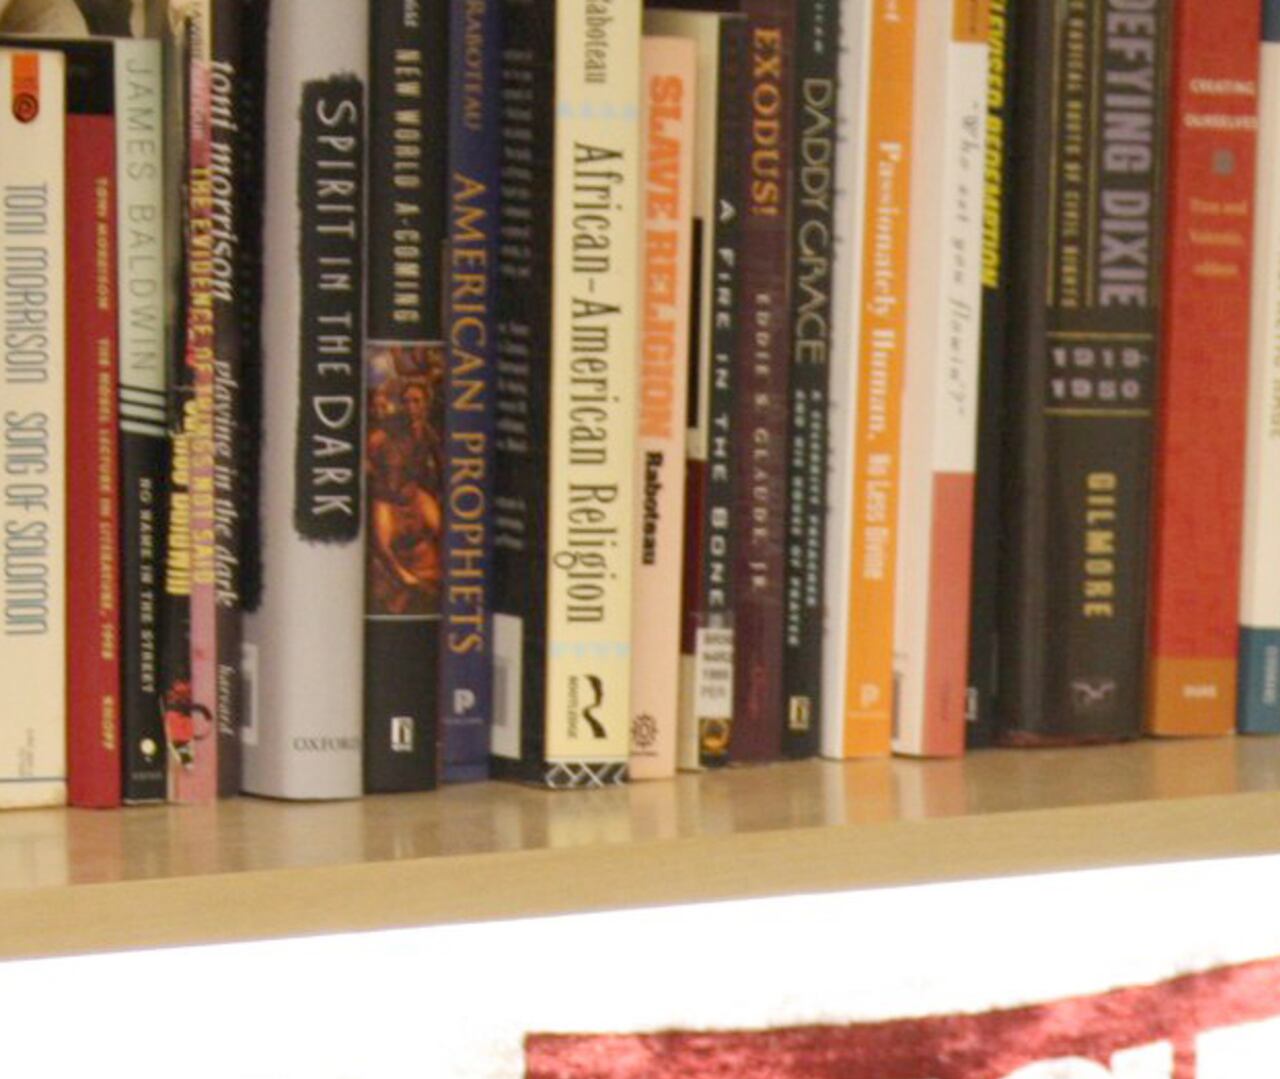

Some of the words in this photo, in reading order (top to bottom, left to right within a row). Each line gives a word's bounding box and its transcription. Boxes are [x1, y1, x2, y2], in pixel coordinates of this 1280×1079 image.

[210, 60, 239, 131] toni
[394, 49, 423, 97] NEW
[125, 59, 157, 181] JAMES
[393, 109, 423, 189] WORLD
[646, 75, 685, 220] SLAVE
[750, 28, 783, 217] EXODUS!
[802, 77, 833, 211] DADDY
[96, 177, 109, 218] TONI
[316, 99, 357, 240] SPIRIT
[4, 184, 47, 236] TONI
[210, 142, 238, 303] morrison
[719, 198, 735, 222] A
[866, 141, 903, 317] Passionately
[1100, 189, 1150, 307] DIXIE
[96, 223, 109, 311] MORRISON
[125, 204, 157, 371] BALDWIN
[317, 257, 351, 291] IN
[452, 172, 488, 411] AMERICAN
[569, 142, 625, 466] African-American
[716, 248, 735, 328] FIRE
[795, 220, 829, 364] GRACE
[3, 247, 48, 384] MORRISON
[98, 338, 111, 367] THE
[317, 312, 352, 375] THE
[640, 230, 681, 441] RELIGION
[756, 293, 771, 375] EDDIE
[715, 355, 730, 390] IN
[3, 411, 49, 474] SONG
[99, 429, 113, 491] LECTURE
[214, 464, 237, 490] in
[311, 394, 355, 515] DARK
[711, 414, 728, 483] THE
[3, 484, 48, 511] OF
[138, 478, 153, 502] NO
[214, 498, 237, 539] the
[640, 451, 664, 567] Raboteau
[866, 480, 891, 522] Less
[139, 510, 153, 559] NAME
[140, 565, 154, 584] IN
[448, 430, 486, 654] PROPHETS
[552, 482, 619, 624] Religion
[1082, 472, 1118, 617] GILMORE
[3, 519, 49, 637] SOLOMON
[140, 591, 154, 622] THE
[214, 545, 238, 608] dark
[140, 629, 154, 693] STREET
